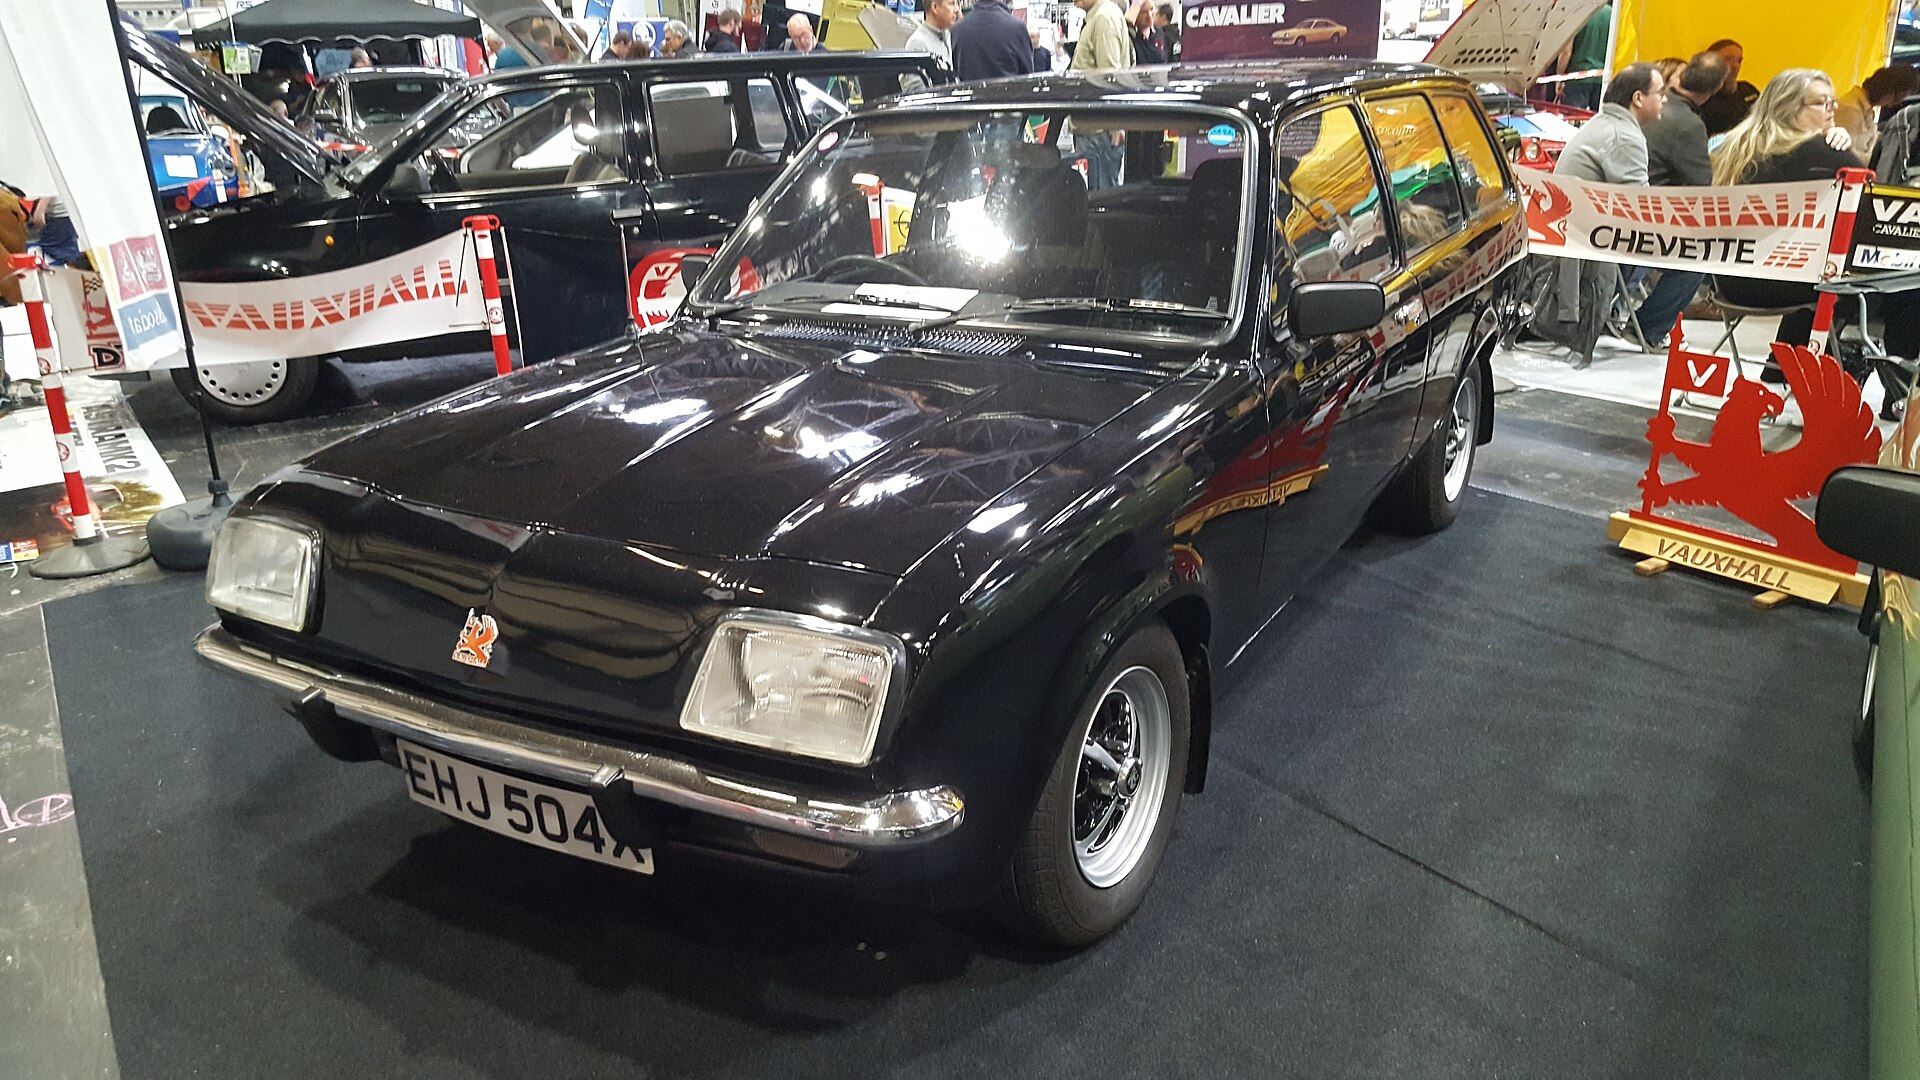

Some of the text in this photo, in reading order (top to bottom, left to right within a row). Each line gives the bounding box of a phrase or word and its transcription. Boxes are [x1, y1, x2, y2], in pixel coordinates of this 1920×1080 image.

[1186, 3, 1286, 28] CAVALIER
[1581, 186, 1826, 229] VAUXHALL
[1589, 225, 1757, 264] CHEVETTE
[1658, 538, 1792, 591] VAUXHALL
[404, 749, 492, 821] EHJ
